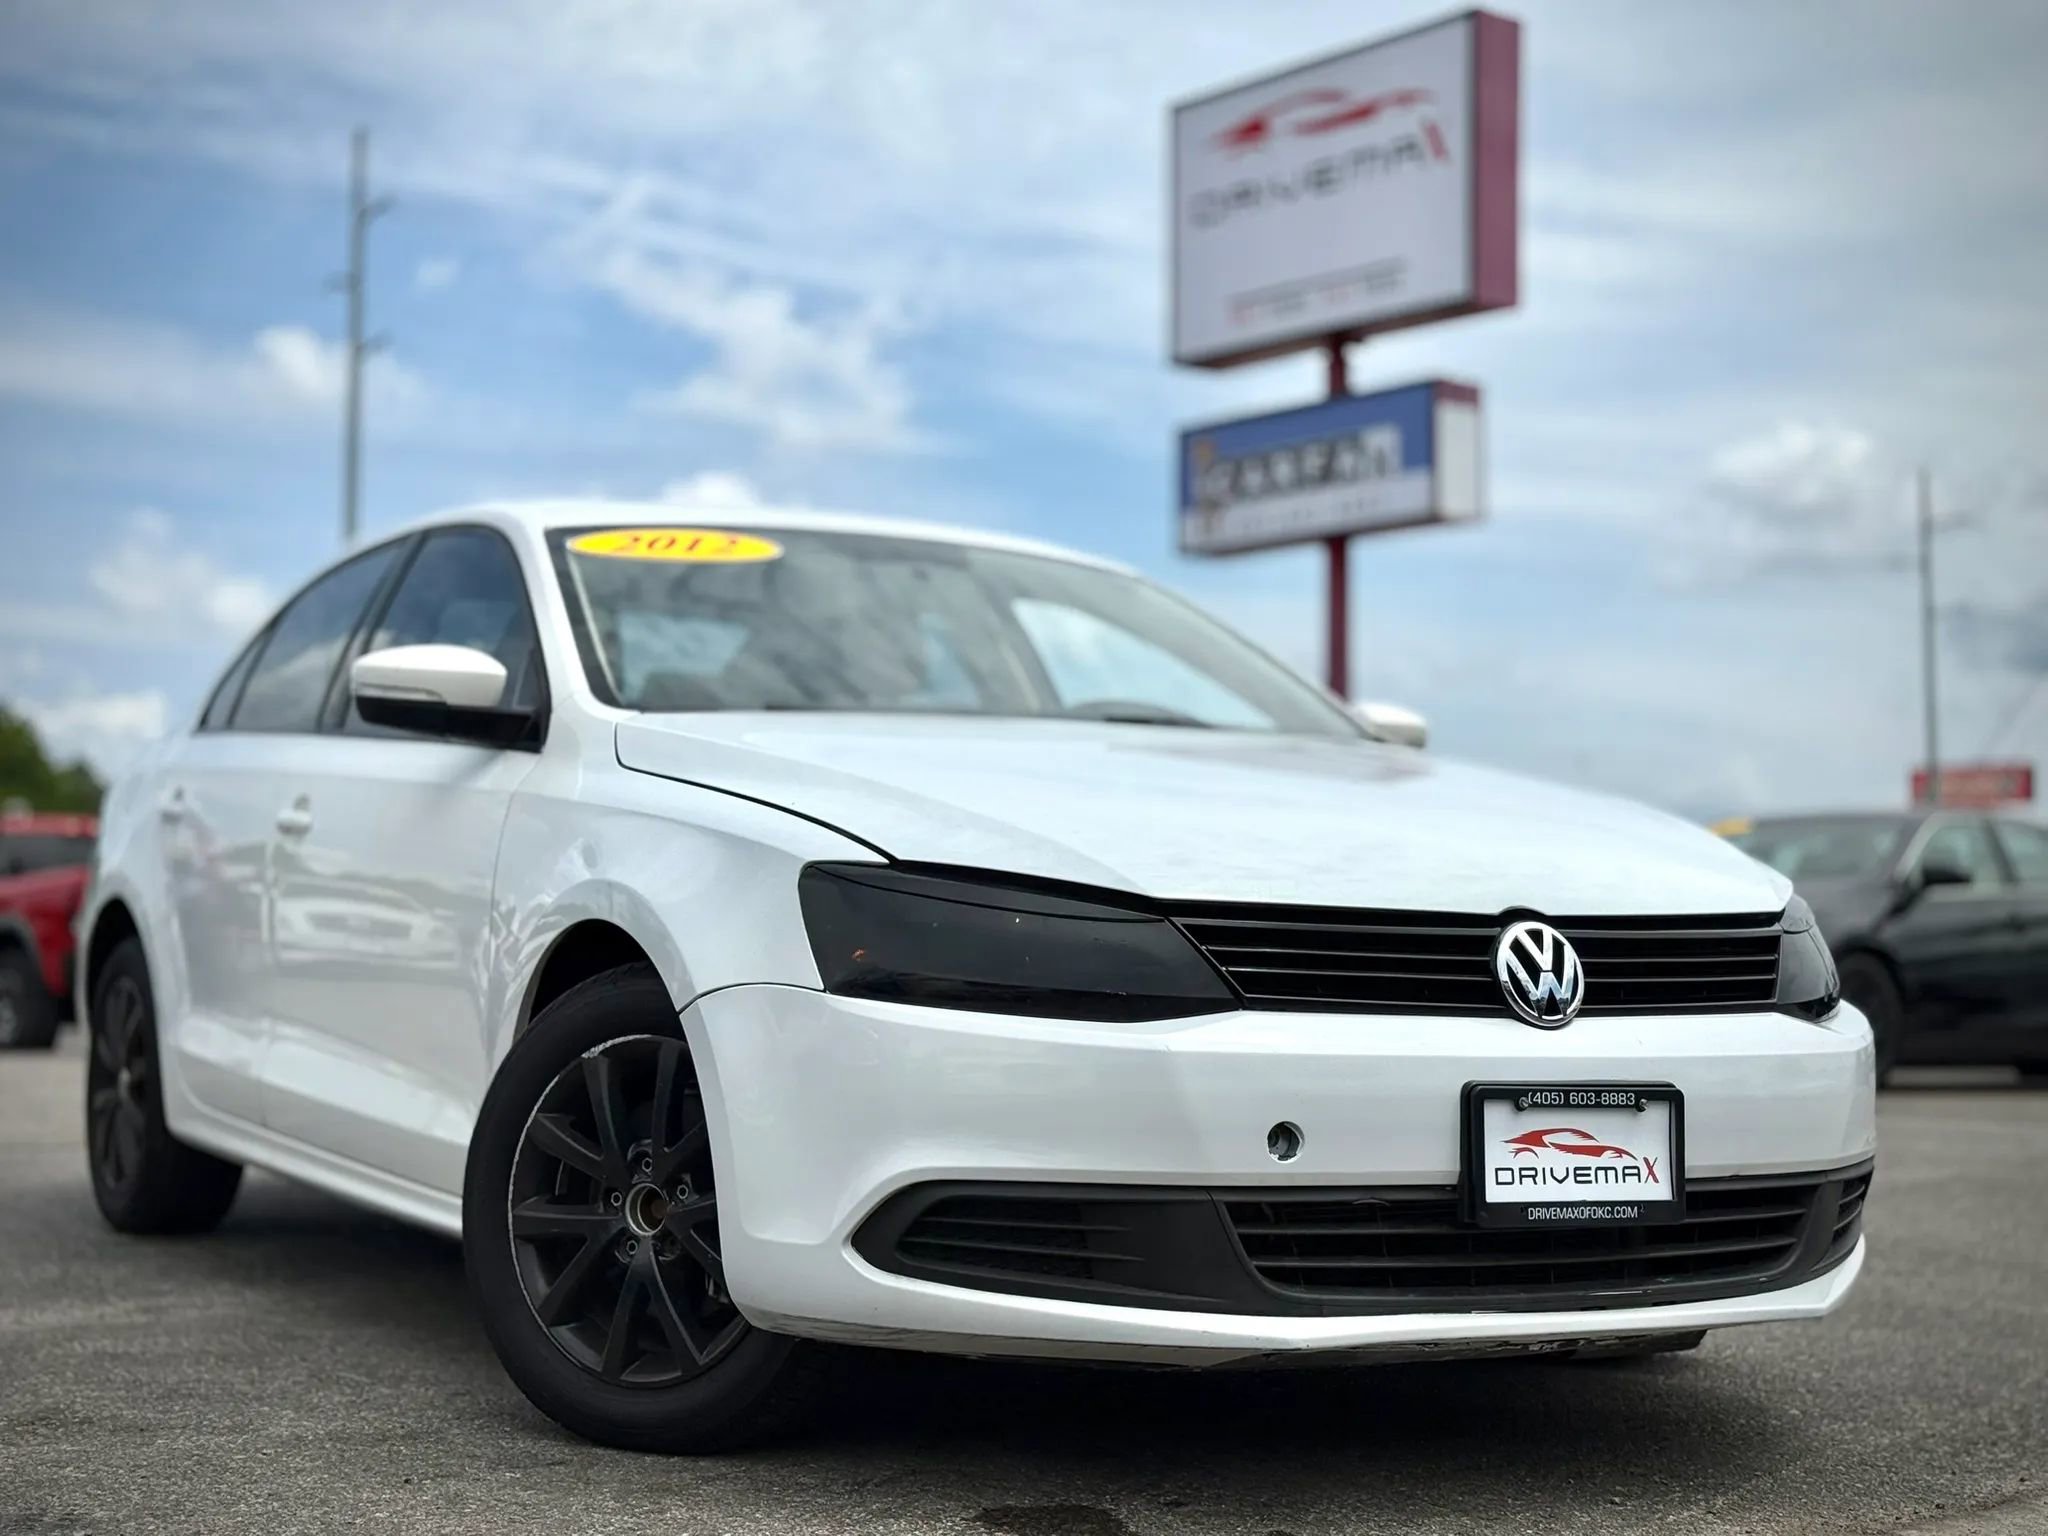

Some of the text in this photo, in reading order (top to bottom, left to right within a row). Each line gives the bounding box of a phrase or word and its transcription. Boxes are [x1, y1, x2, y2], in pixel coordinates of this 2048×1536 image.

[608, 534, 739, 555] 2012
[1527, 1091, 1636, 1106] (405) 603-8883
[1494, 1156, 1660, 1186] DRIVEMAX
[1527, 1205, 1639, 1221] DRIVEMAXOFOKC.COM
